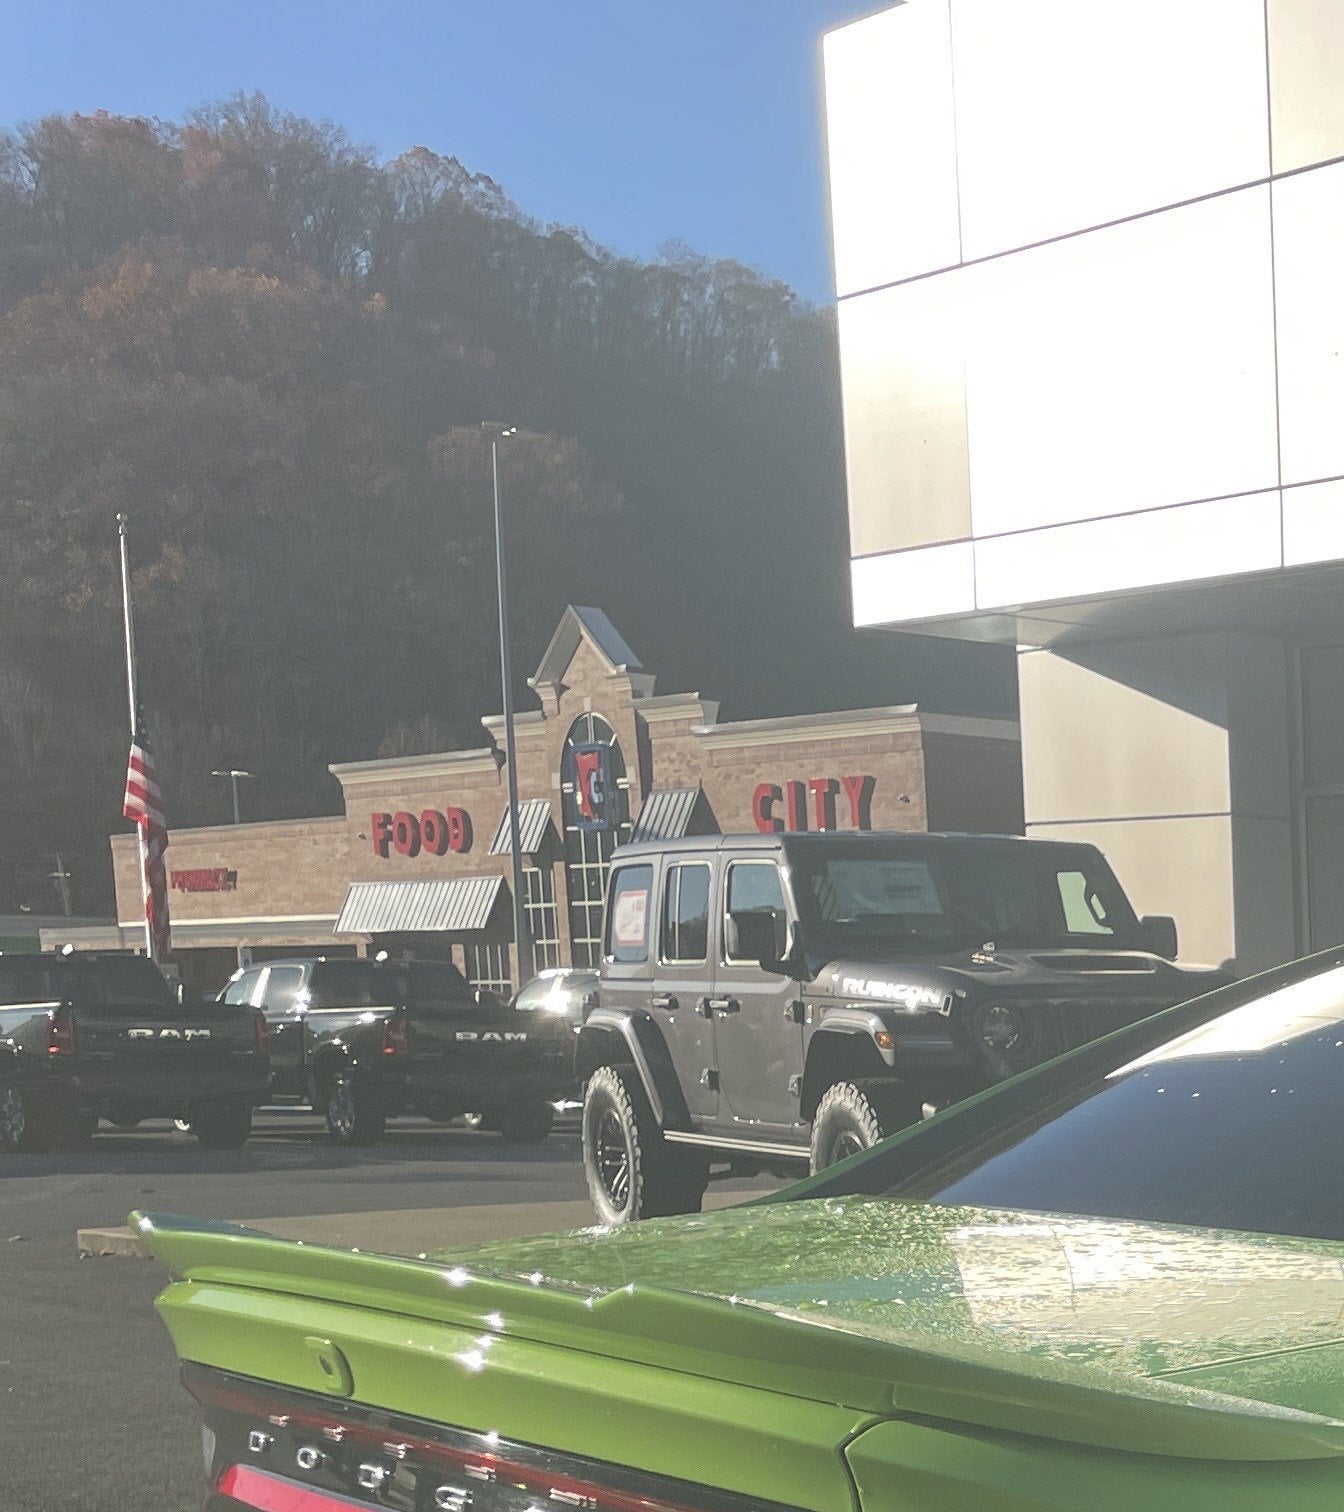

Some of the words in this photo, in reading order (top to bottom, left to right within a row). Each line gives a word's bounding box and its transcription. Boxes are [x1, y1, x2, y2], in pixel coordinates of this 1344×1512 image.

[371, 806, 473, 858] FOOD
[752, 775, 876, 832] CITY
[127, 1028, 211, 1041] RAM
[454, 1031, 527, 1041] RAM
